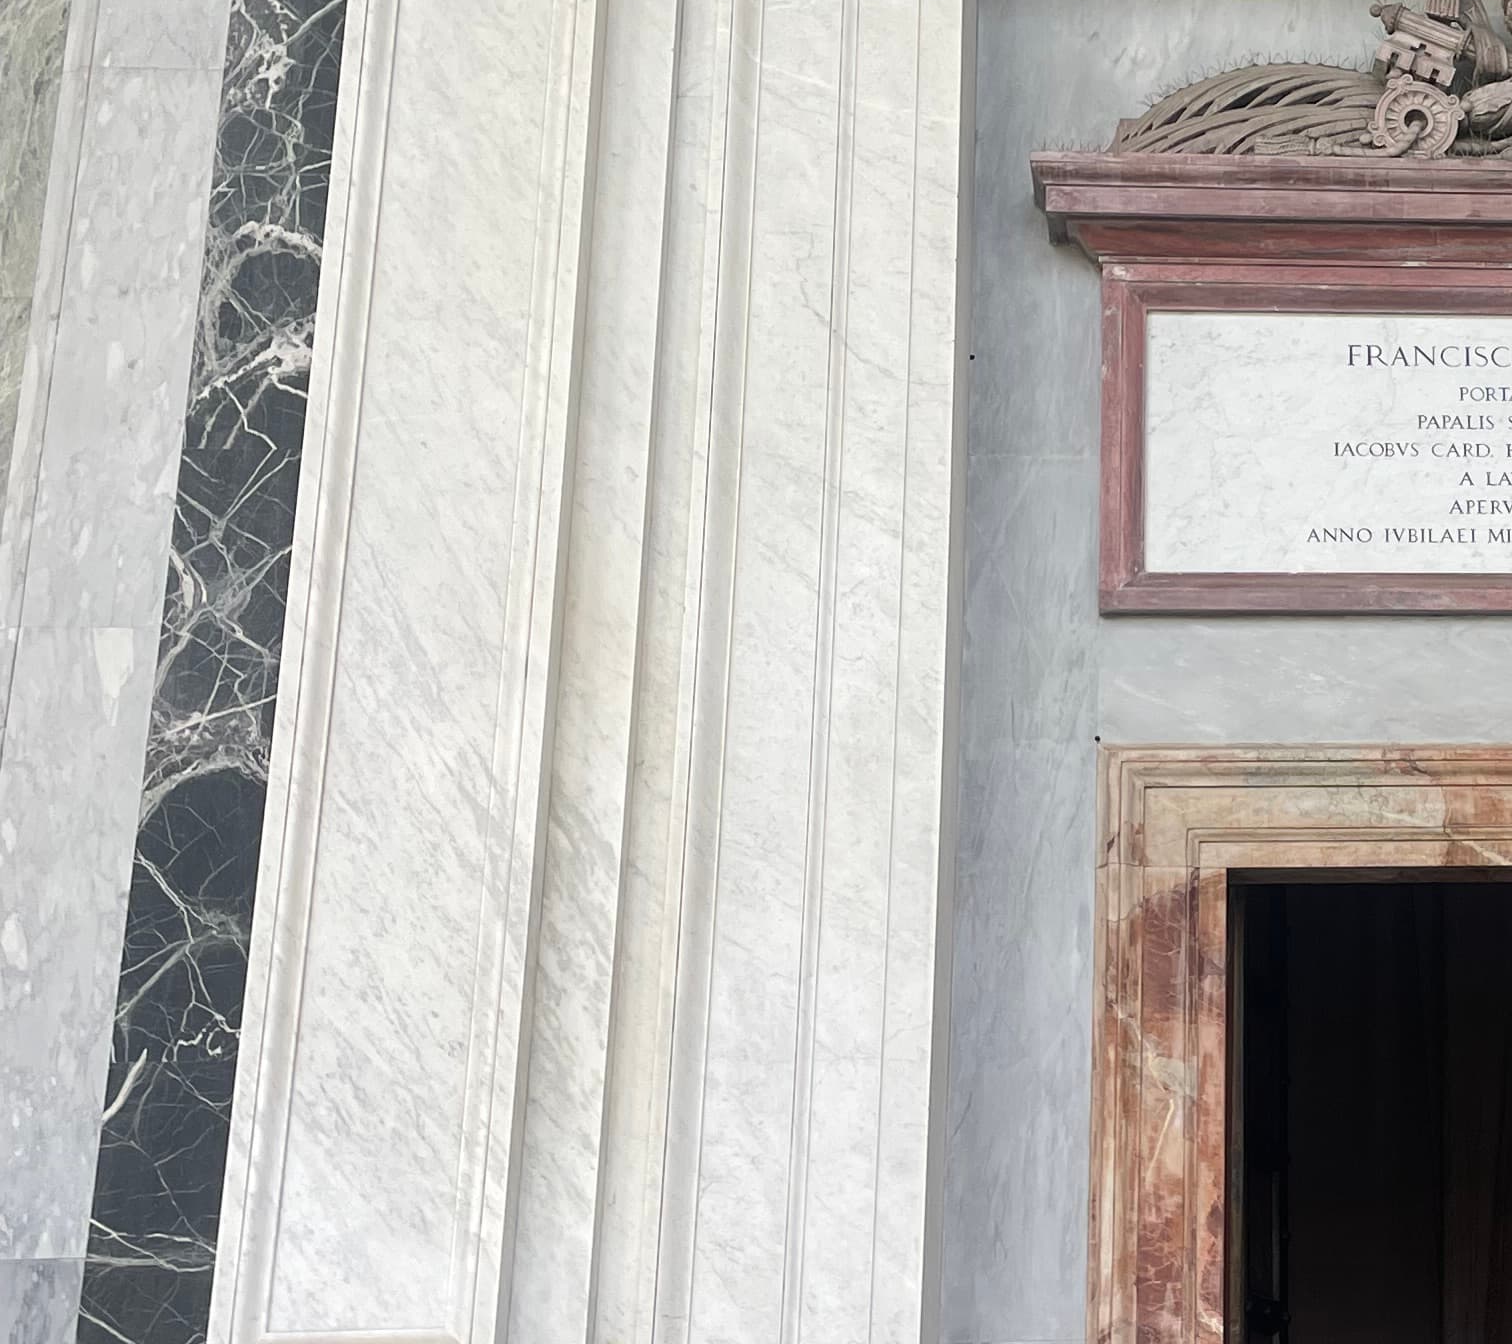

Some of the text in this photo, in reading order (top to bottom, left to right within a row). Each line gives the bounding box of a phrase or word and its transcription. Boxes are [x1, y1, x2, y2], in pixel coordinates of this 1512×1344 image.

[1417, 414, 1495, 430] PAPALIS
[1333, 441, 1420, 457] IACOBVS
[1431, 442, 1494, 458] CARD.
[1458, 471, 1475, 486] A
[1306, 527, 1373, 543] ANNO
[1384, 527, 1476, 544] IVBILAEI
